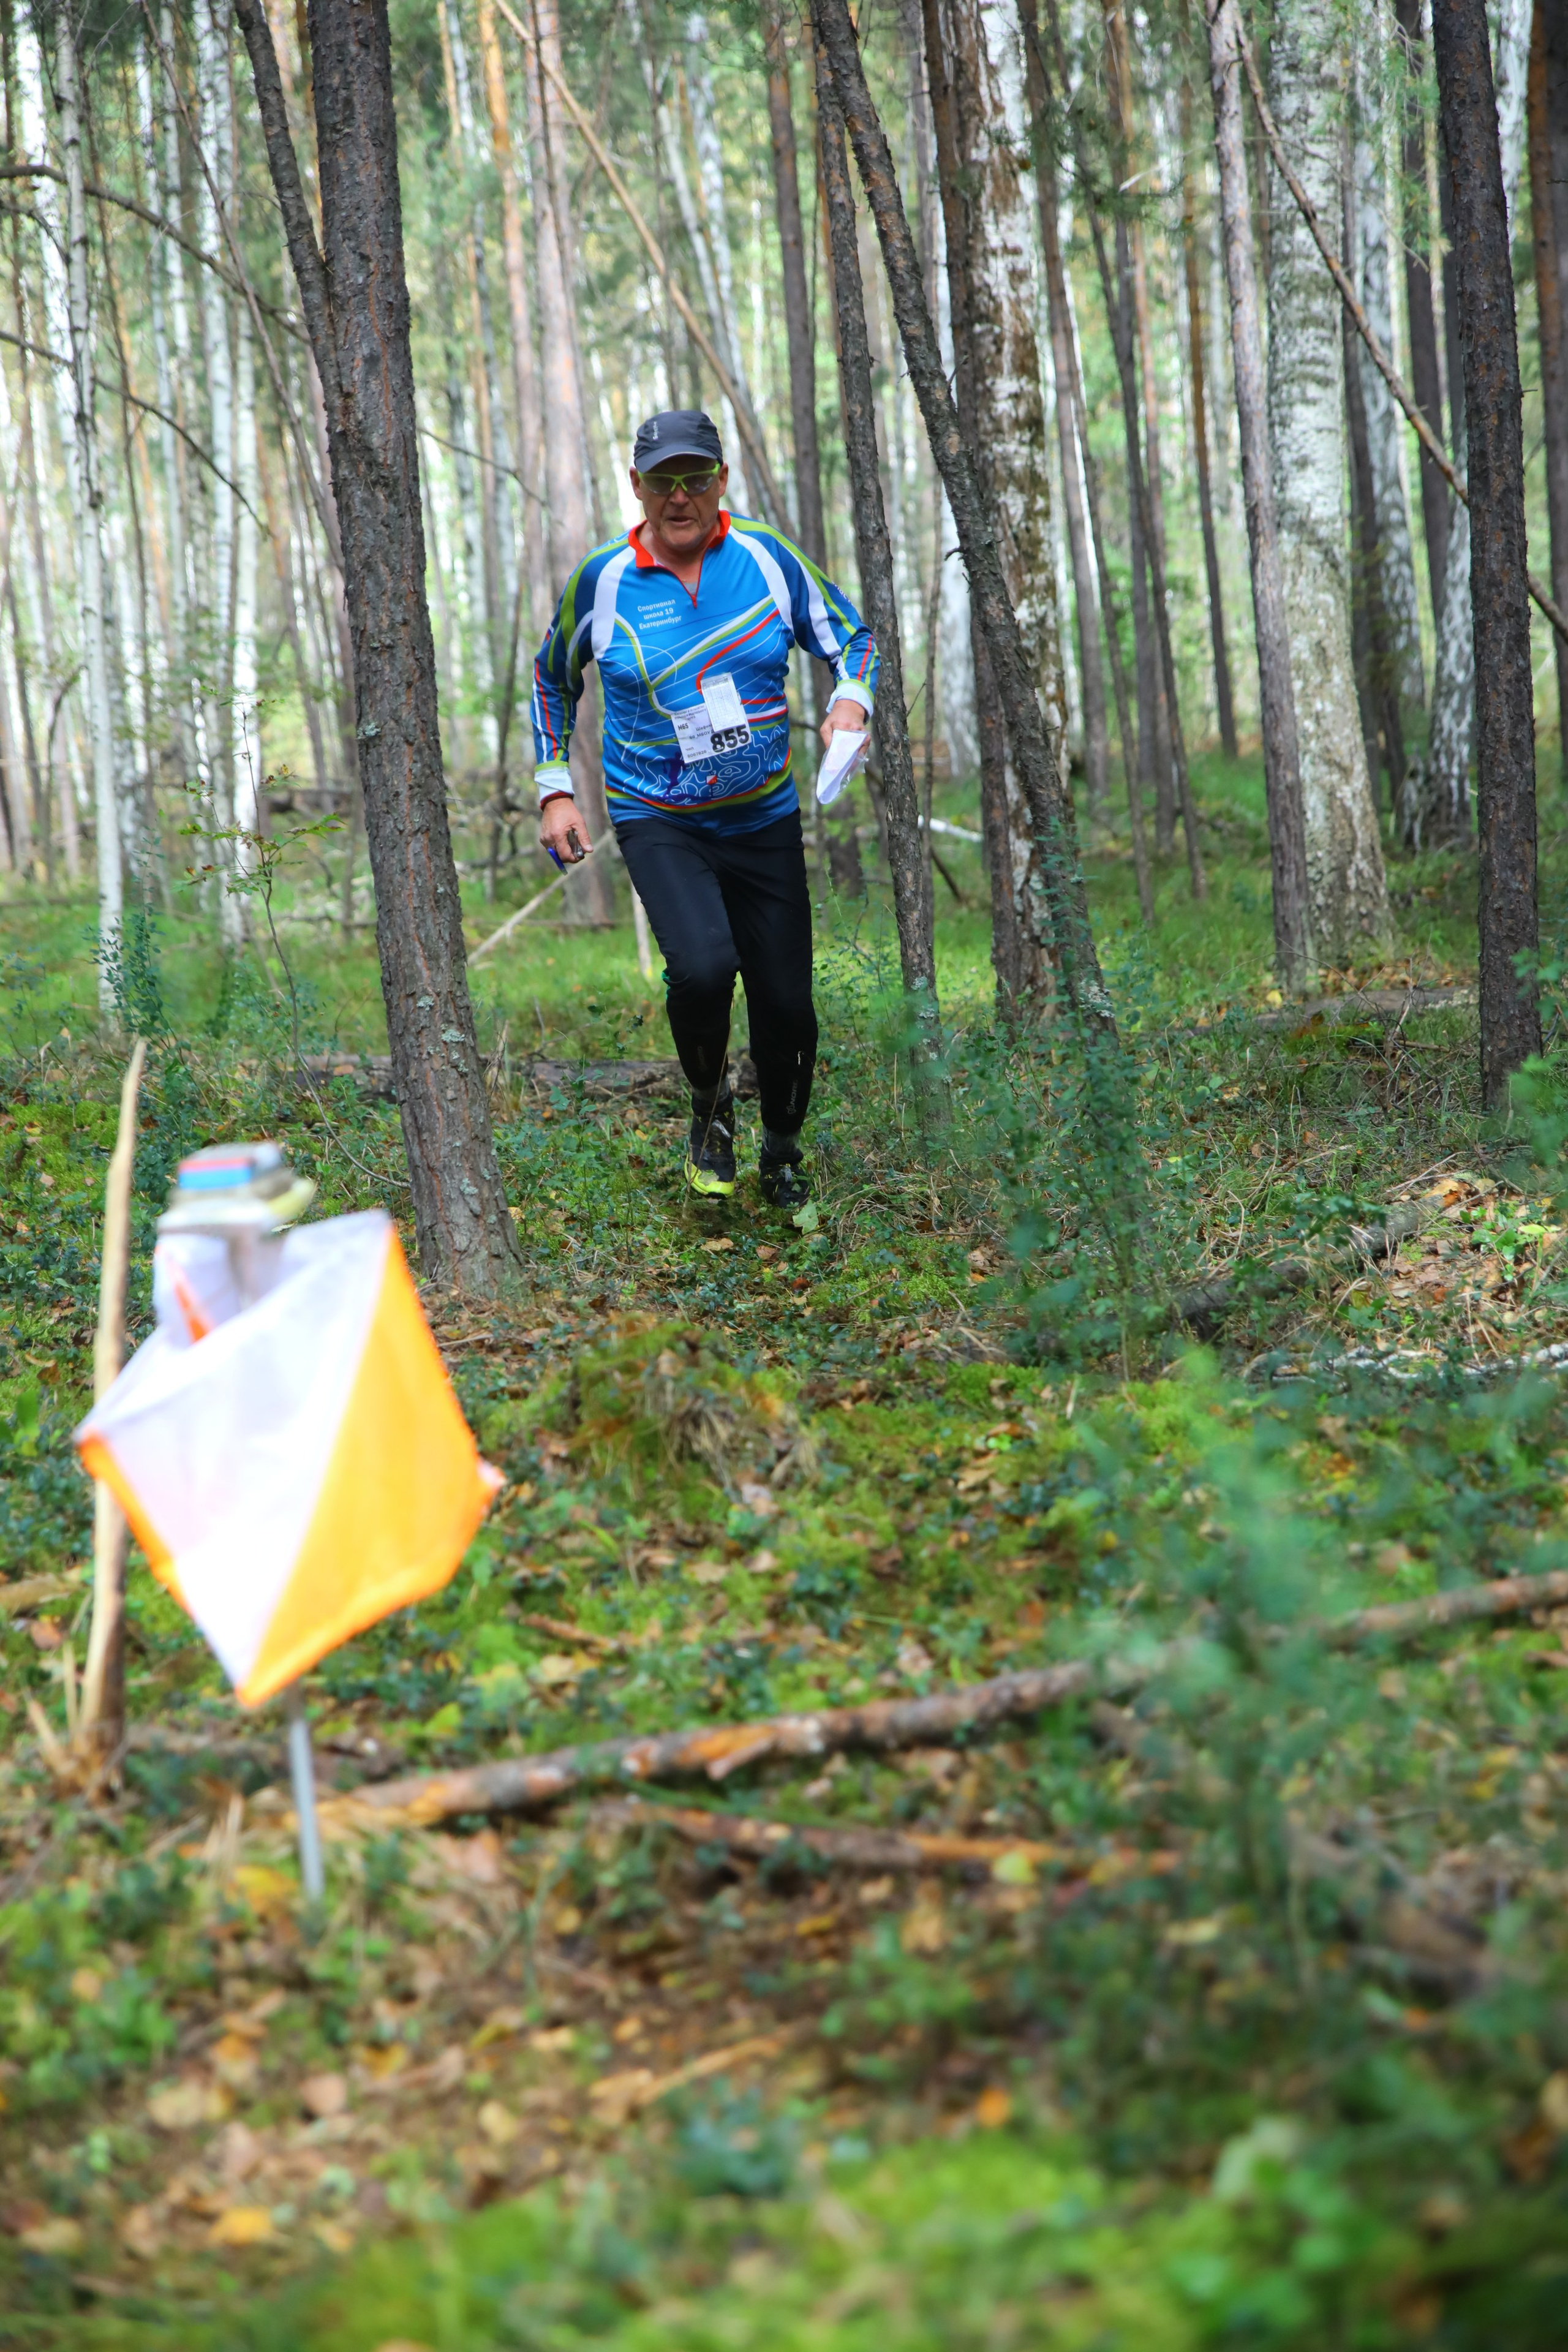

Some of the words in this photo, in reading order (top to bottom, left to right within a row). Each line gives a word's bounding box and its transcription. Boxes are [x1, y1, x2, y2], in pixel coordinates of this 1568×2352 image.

[637, 599, 676, 612] Спортивная
[643, 611, 663, 620] школа
[639, 616, 682, 630] Екатеринбург
[710, 724, 750, 753] 855
